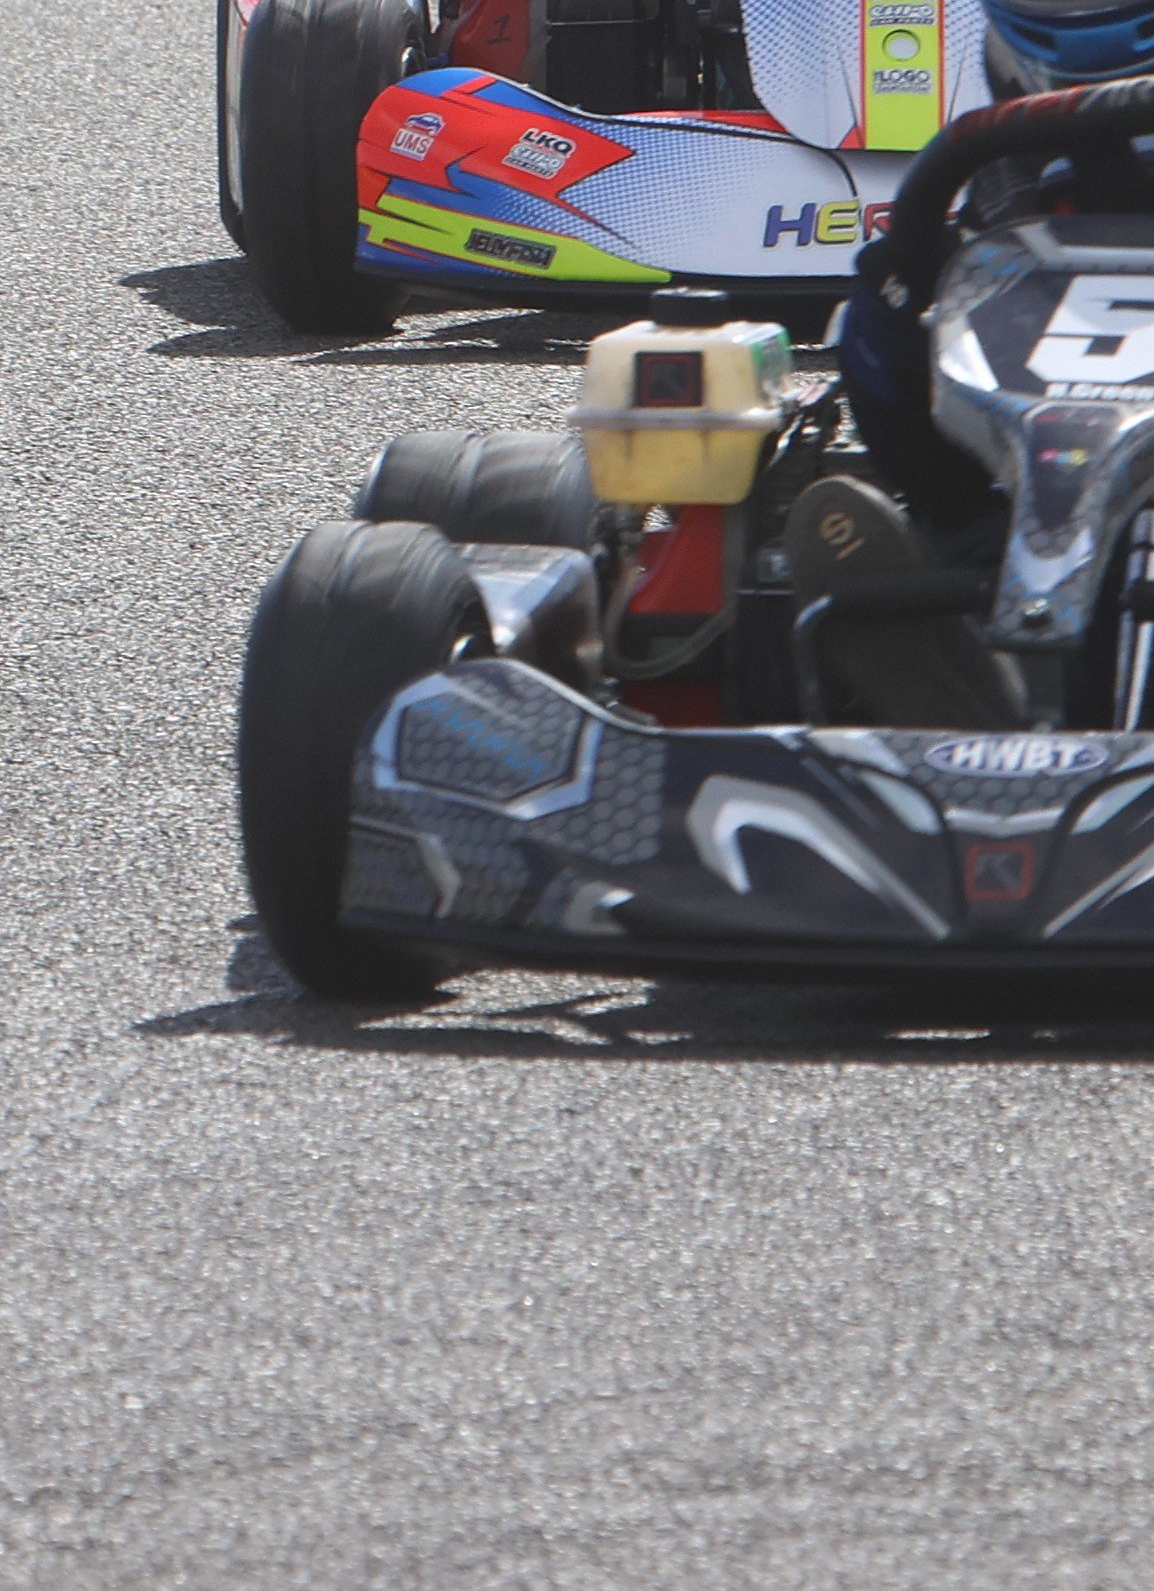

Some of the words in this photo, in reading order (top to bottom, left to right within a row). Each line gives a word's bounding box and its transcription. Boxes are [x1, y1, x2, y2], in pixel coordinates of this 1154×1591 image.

[393, 129, 431, 156] UMS
[521, 129, 574, 155] LKQ
[952, 737, 1082, 772] HWBT
